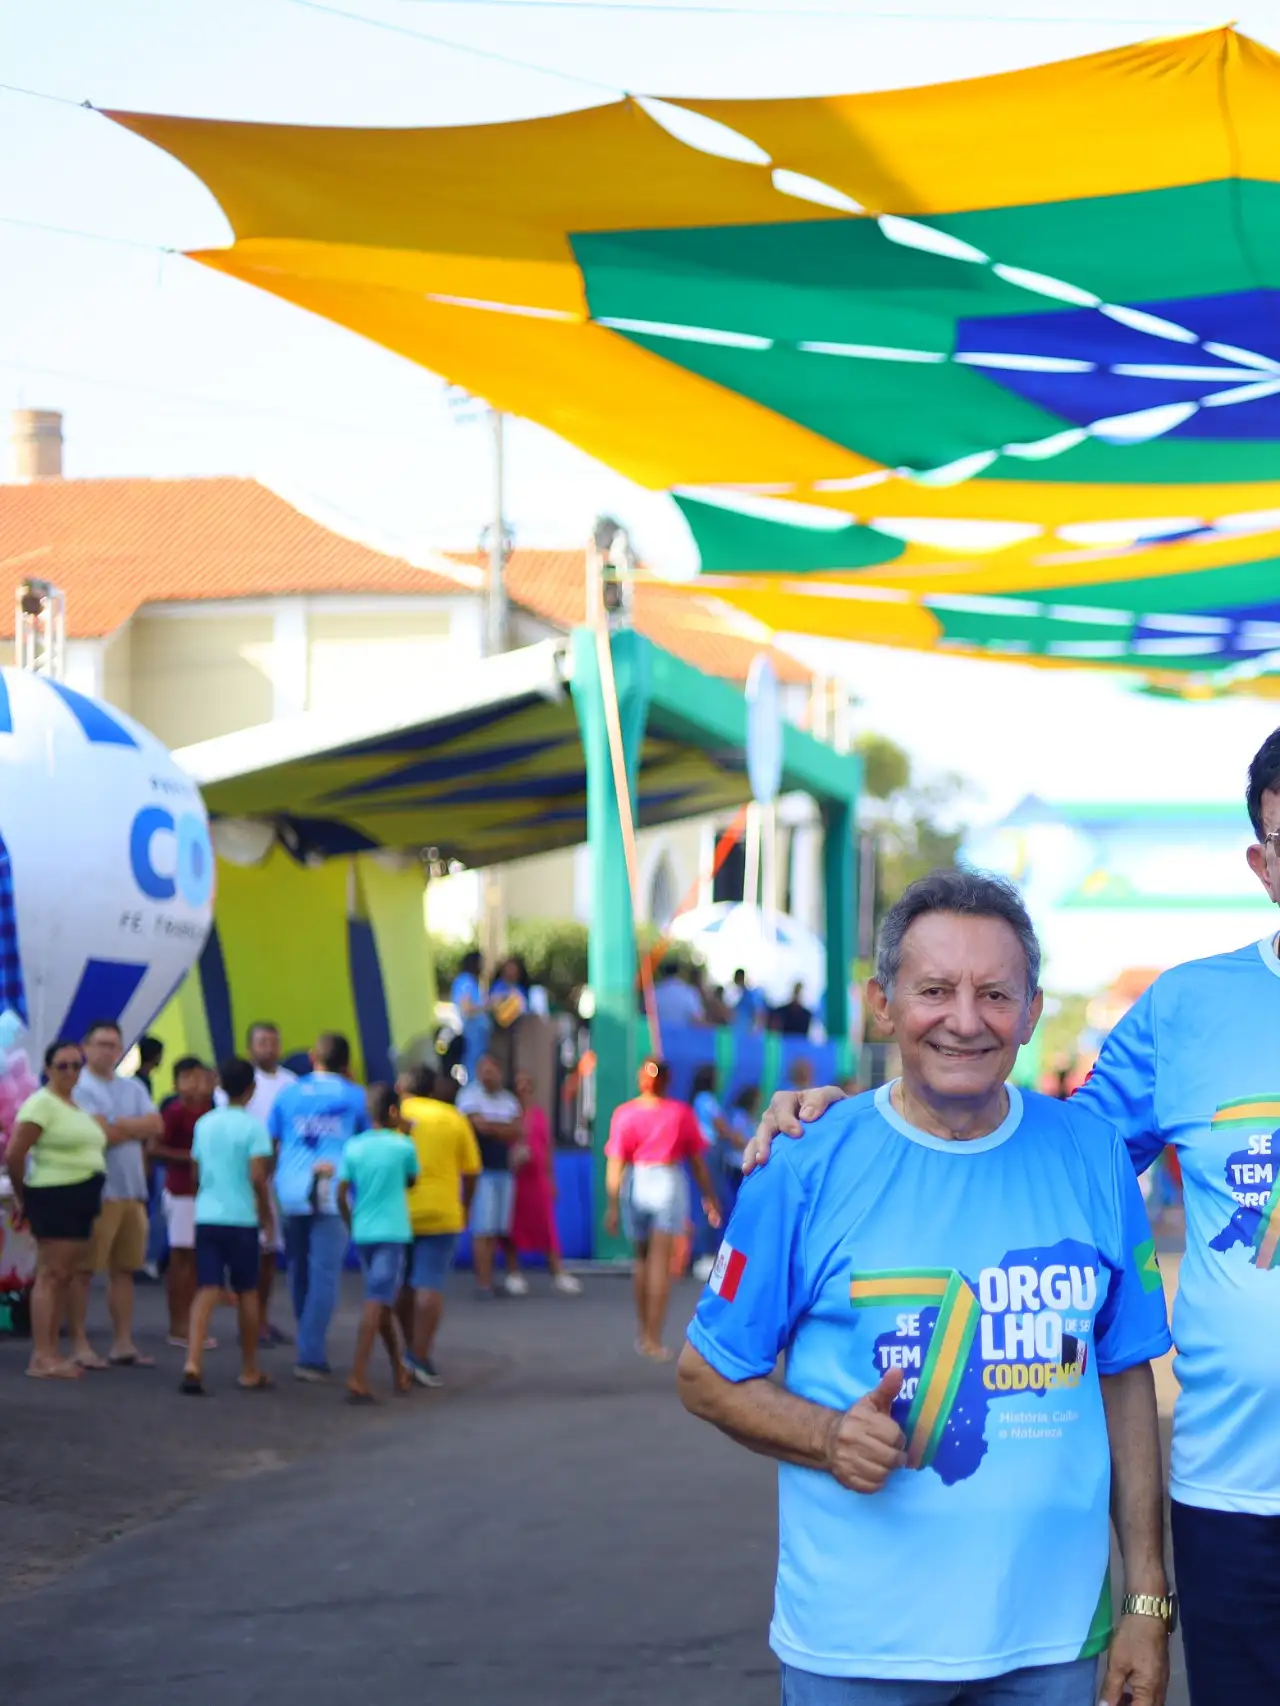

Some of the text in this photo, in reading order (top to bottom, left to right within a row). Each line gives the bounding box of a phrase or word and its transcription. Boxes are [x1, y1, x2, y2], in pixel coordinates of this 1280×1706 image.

[1247, 1134, 1273, 1155] SE
[1231, 1163, 1273, 1185] TEM
[978, 1265, 1097, 1313] ORGU
[895, 1313, 921, 1337] SE
[979, 1311, 1063, 1361] LHO
[1064, 1319, 1078, 1332] DE
[878, 1345, 921, 1369] TEM
